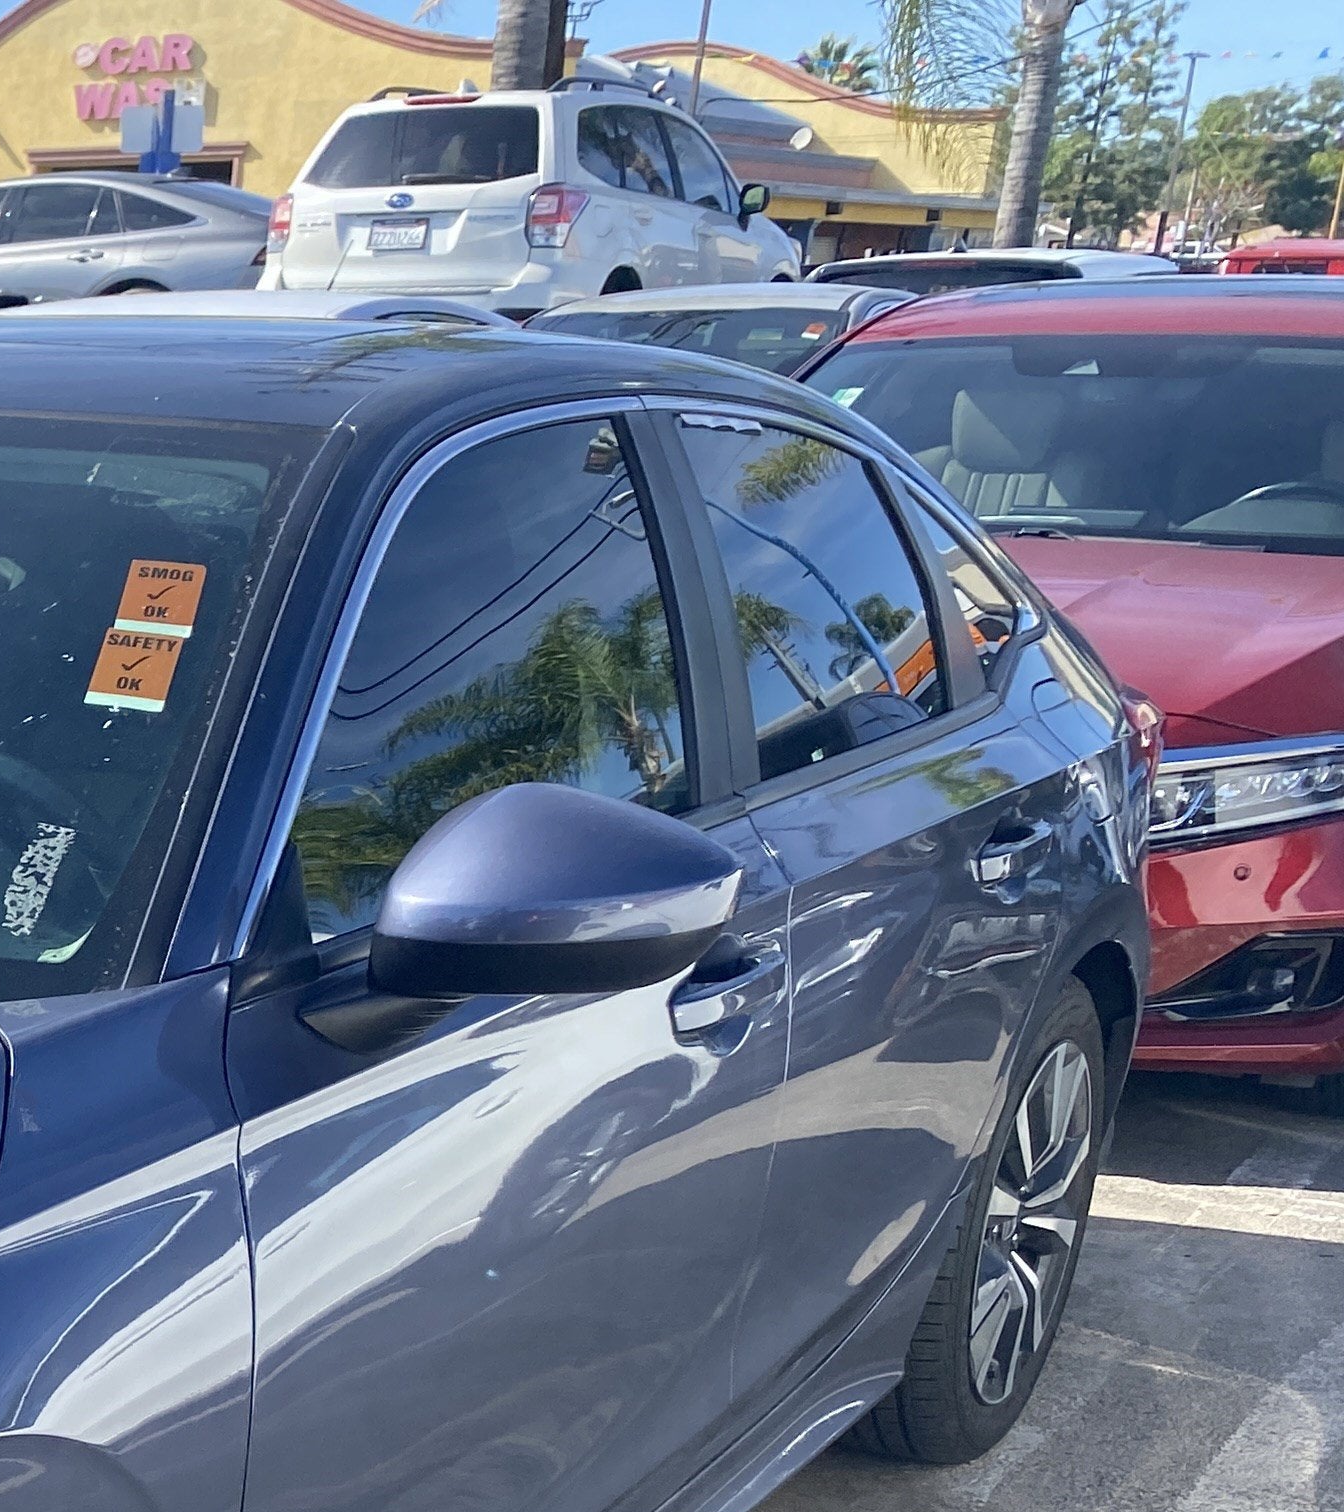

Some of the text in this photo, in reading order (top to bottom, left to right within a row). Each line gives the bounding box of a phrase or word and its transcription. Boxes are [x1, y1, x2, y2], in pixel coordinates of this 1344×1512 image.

[98, 33, 194, 75] CAR
[138, 566, 194, 582] SMOG
[143, 604, 171, 618] OK
[106, 633, 179, 652] SAFETY
[116, 676, 144, 691] OK
